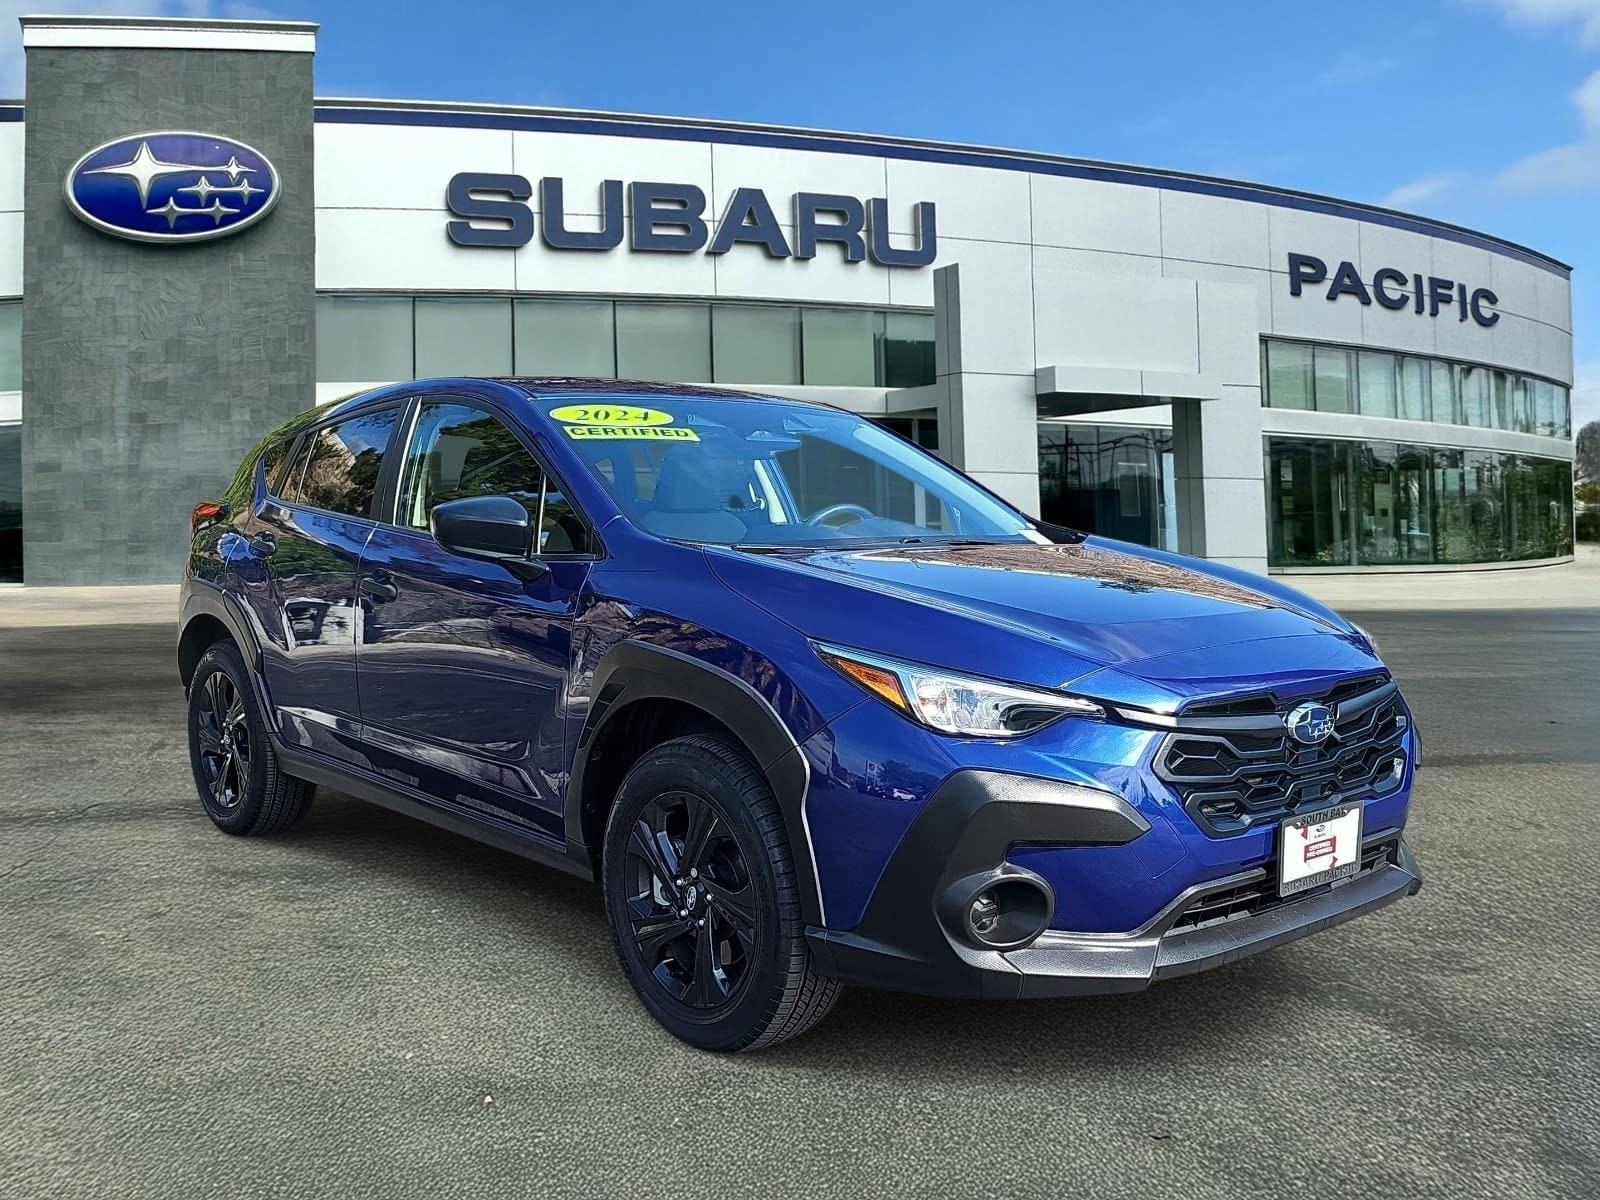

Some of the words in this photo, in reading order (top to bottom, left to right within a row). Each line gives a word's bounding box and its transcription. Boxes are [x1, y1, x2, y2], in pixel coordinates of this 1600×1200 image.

[447, 171, 938, 268] SUBARU
[1288, 252, 1500, 328] PACIFIC
[575, 409, 650, 422] 2024
[570, 427, 689, 438] CERTIFIED
[1301, 811, 1329, 826] SOUTH
[1330, 806, 1345, 819] BAY
